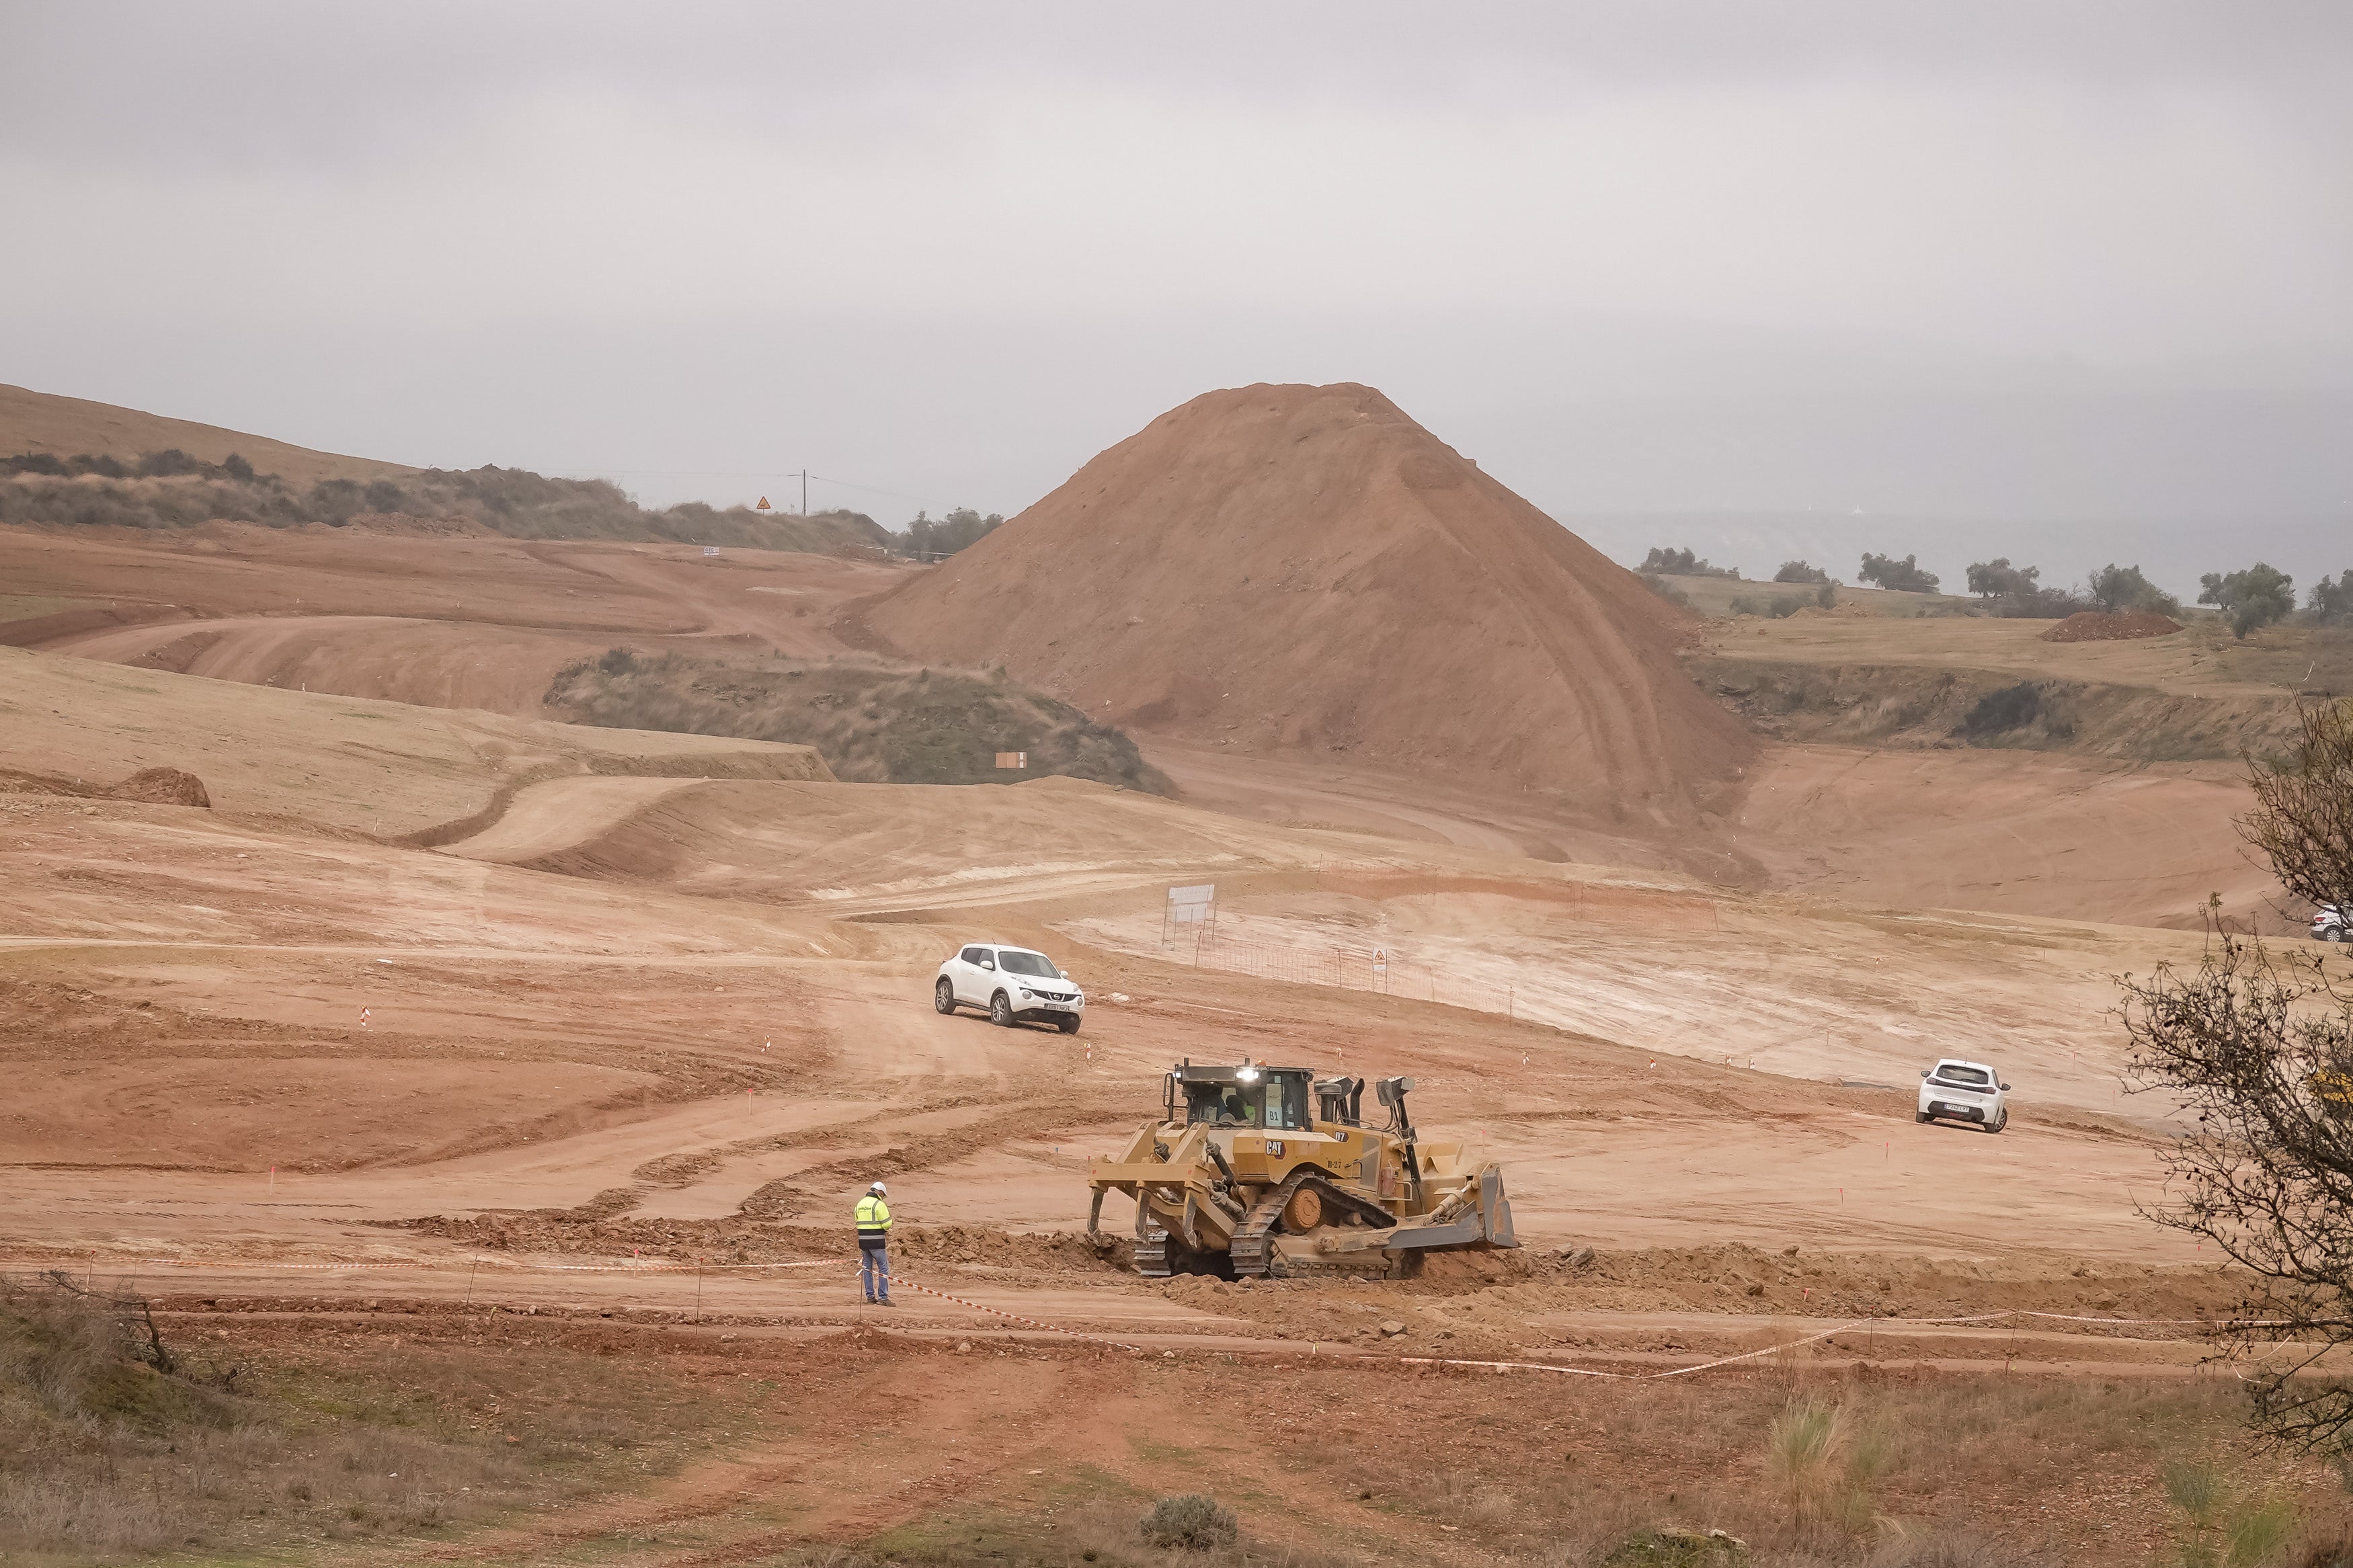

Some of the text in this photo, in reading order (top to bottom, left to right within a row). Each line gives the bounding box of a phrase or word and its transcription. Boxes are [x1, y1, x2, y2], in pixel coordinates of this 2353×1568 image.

[1269, 1111, 1279, 1120] B1
[1335, 1132, 1345, 1141] D7
[1267, 1141, 1281, 1155] CAT
[1328, 1161, 1341, 1169] B-27
